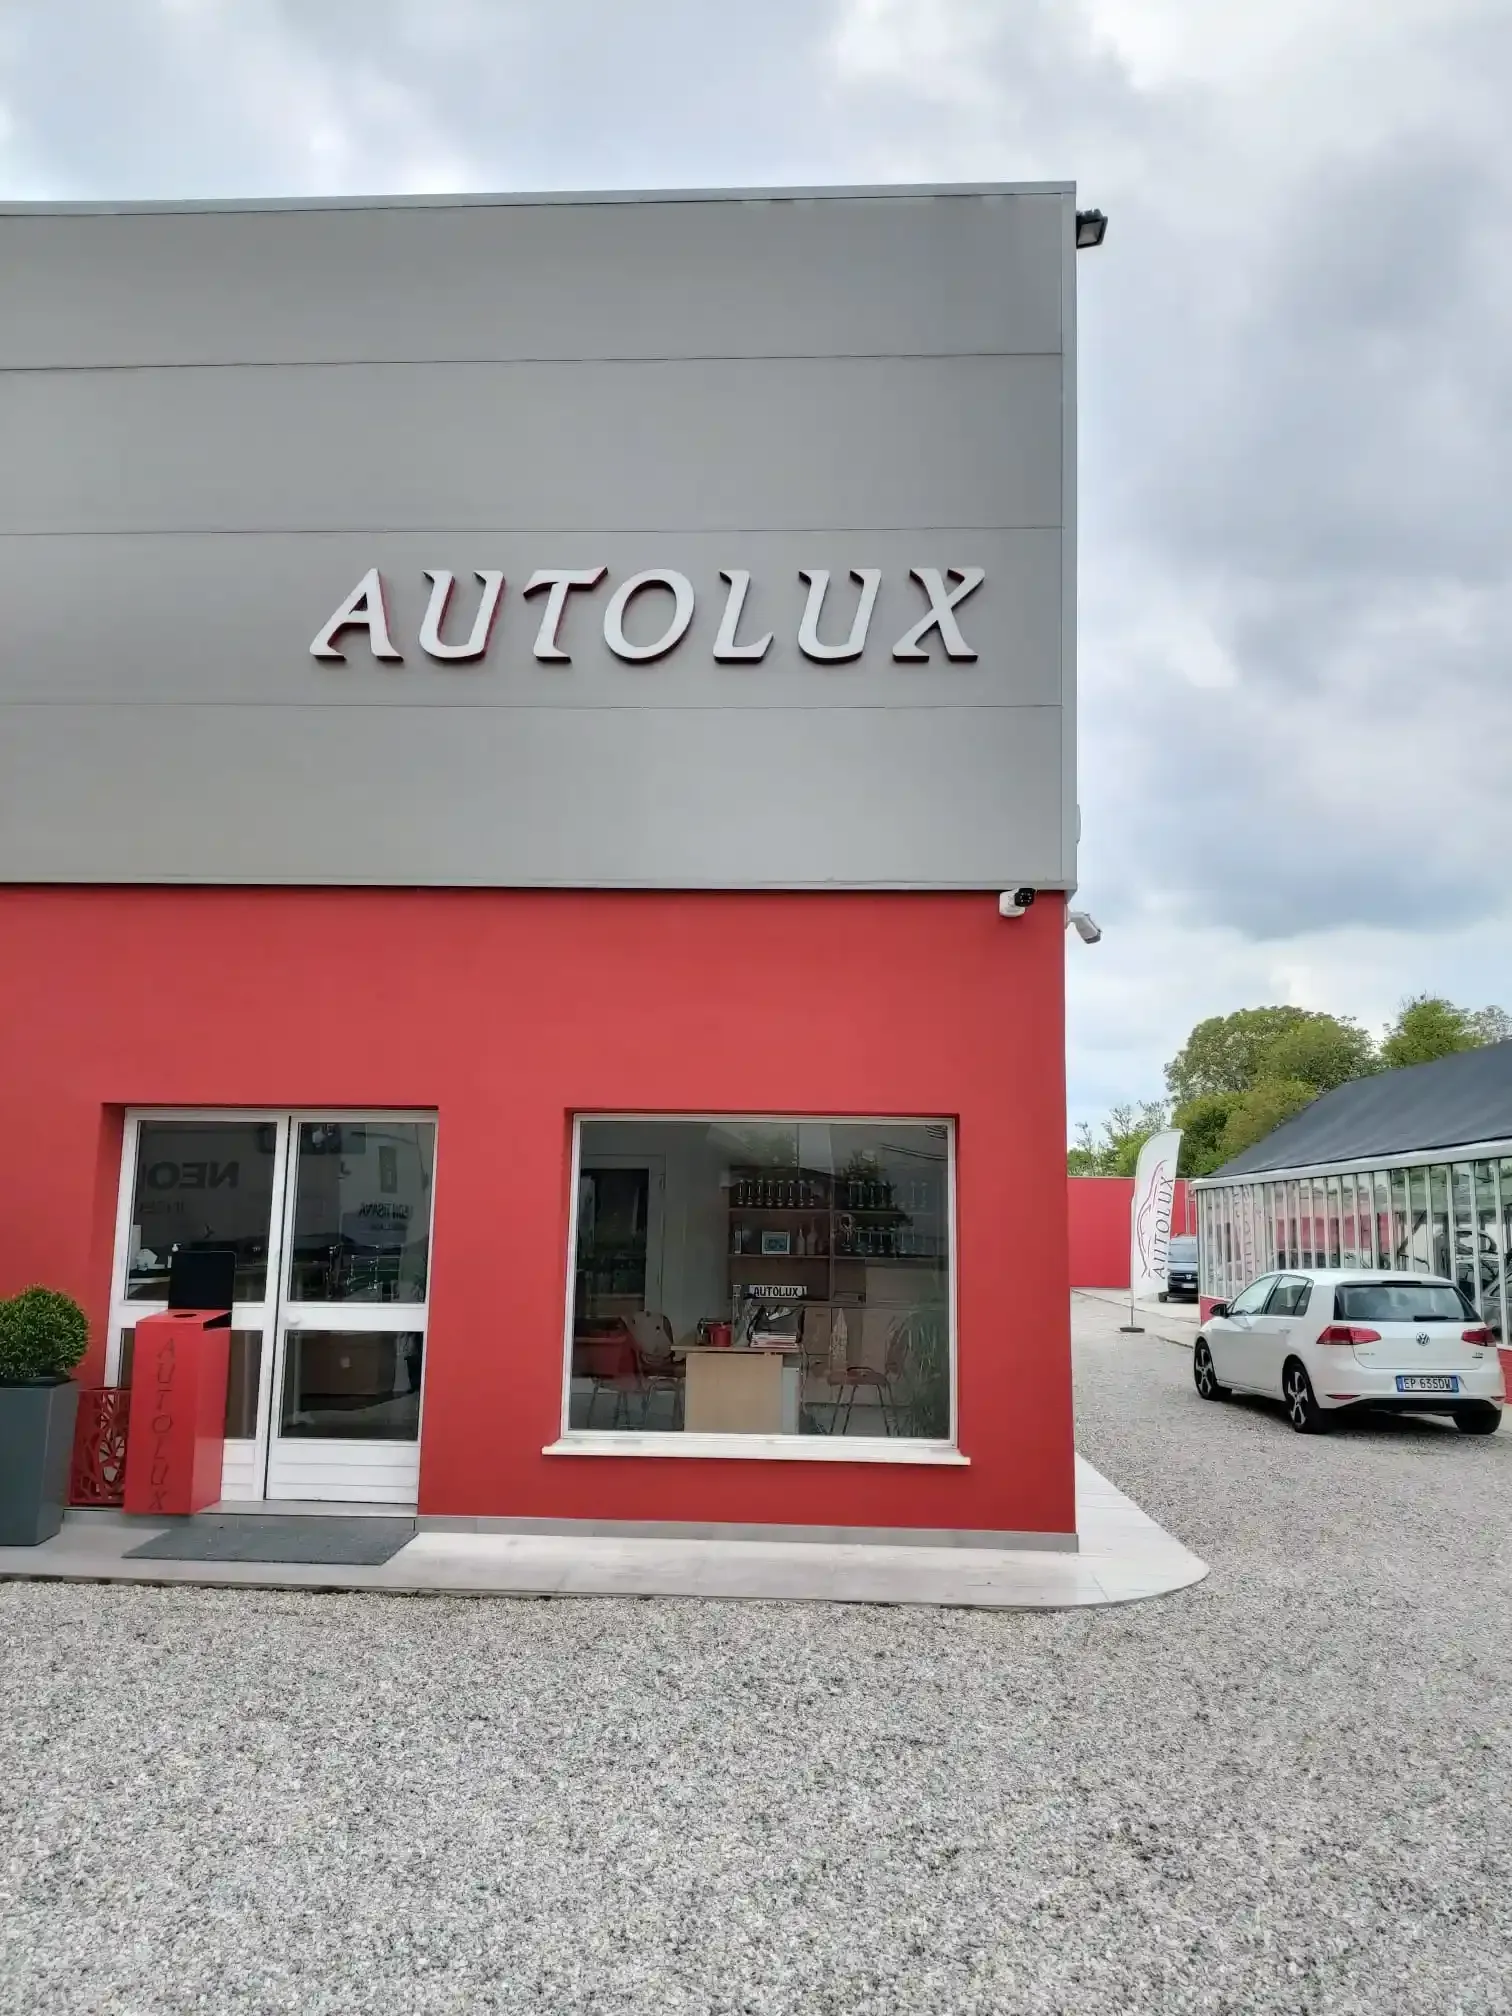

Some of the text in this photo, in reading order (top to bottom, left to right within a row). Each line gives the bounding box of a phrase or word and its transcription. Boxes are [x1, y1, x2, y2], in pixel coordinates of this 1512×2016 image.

[308, 565, 987, 664] AUTOLUX
[1152, 1176, 1174, 1280] AUTOLUX
[753, 1286, 798, 1297] AUTOLUX
[149, 1337, 175, 1511] AUTOLUX
[1403, 1378, 1416, 1389] EP
